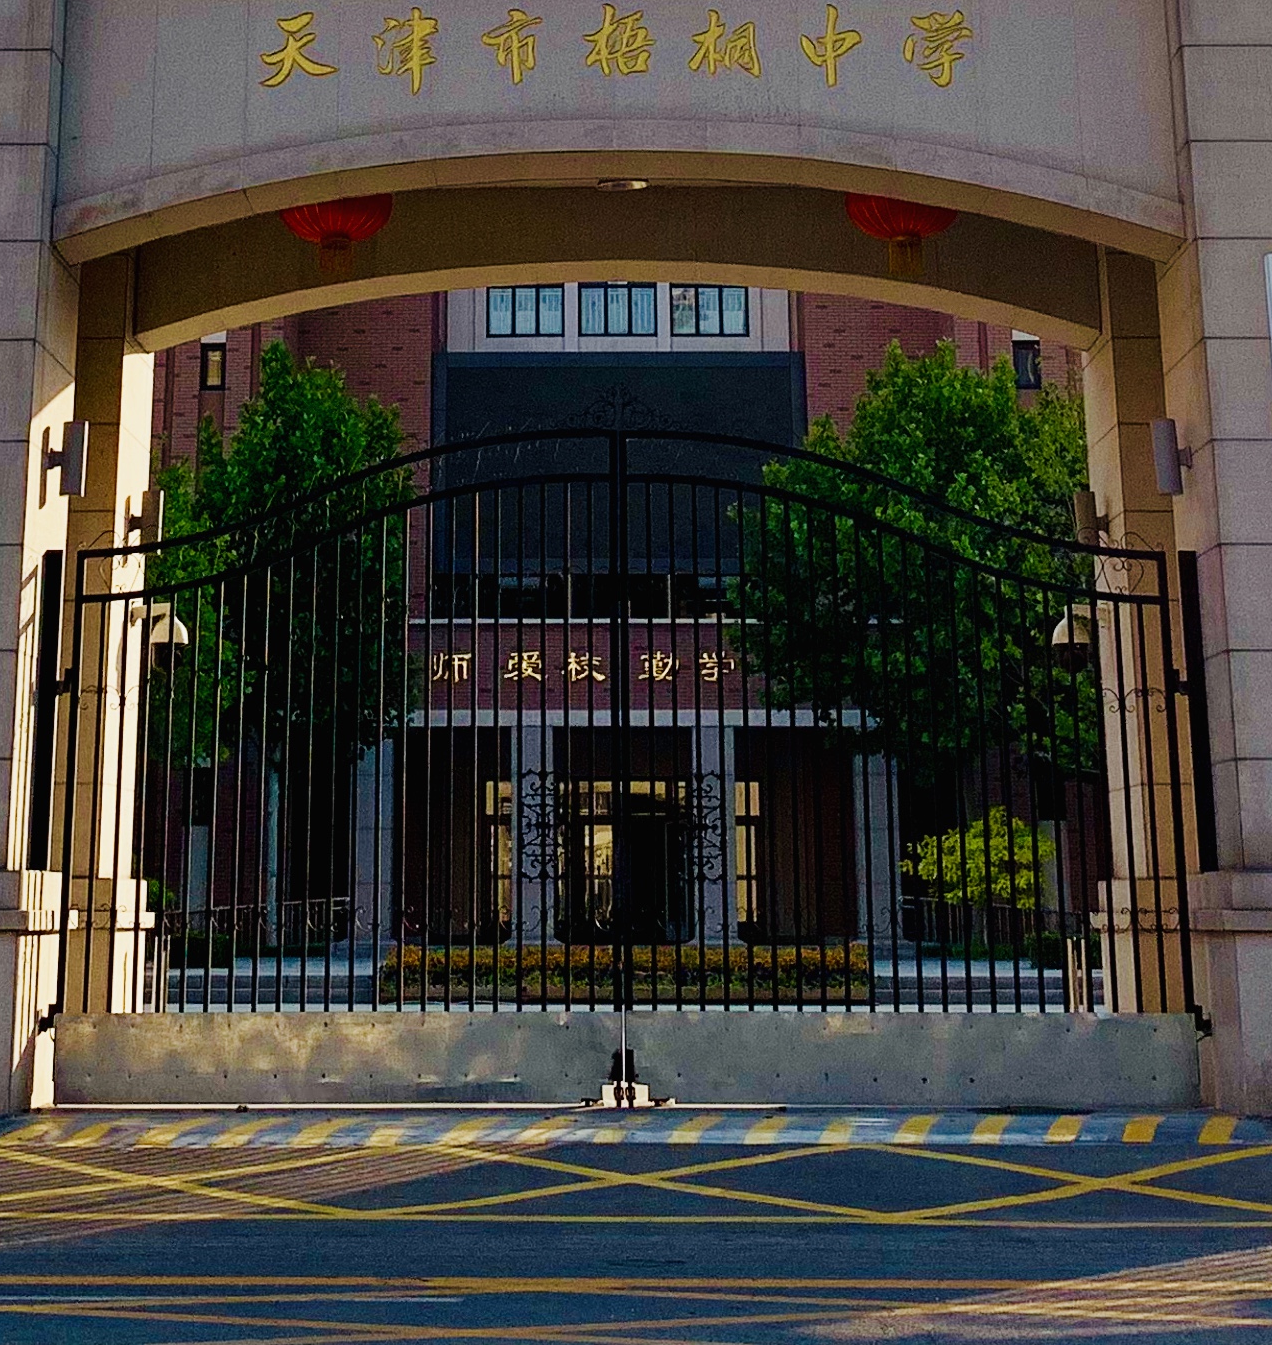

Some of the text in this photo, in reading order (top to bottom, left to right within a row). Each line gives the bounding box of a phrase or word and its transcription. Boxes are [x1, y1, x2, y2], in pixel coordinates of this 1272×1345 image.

[259, 2, 974, 96] 天津市梧桐中学
